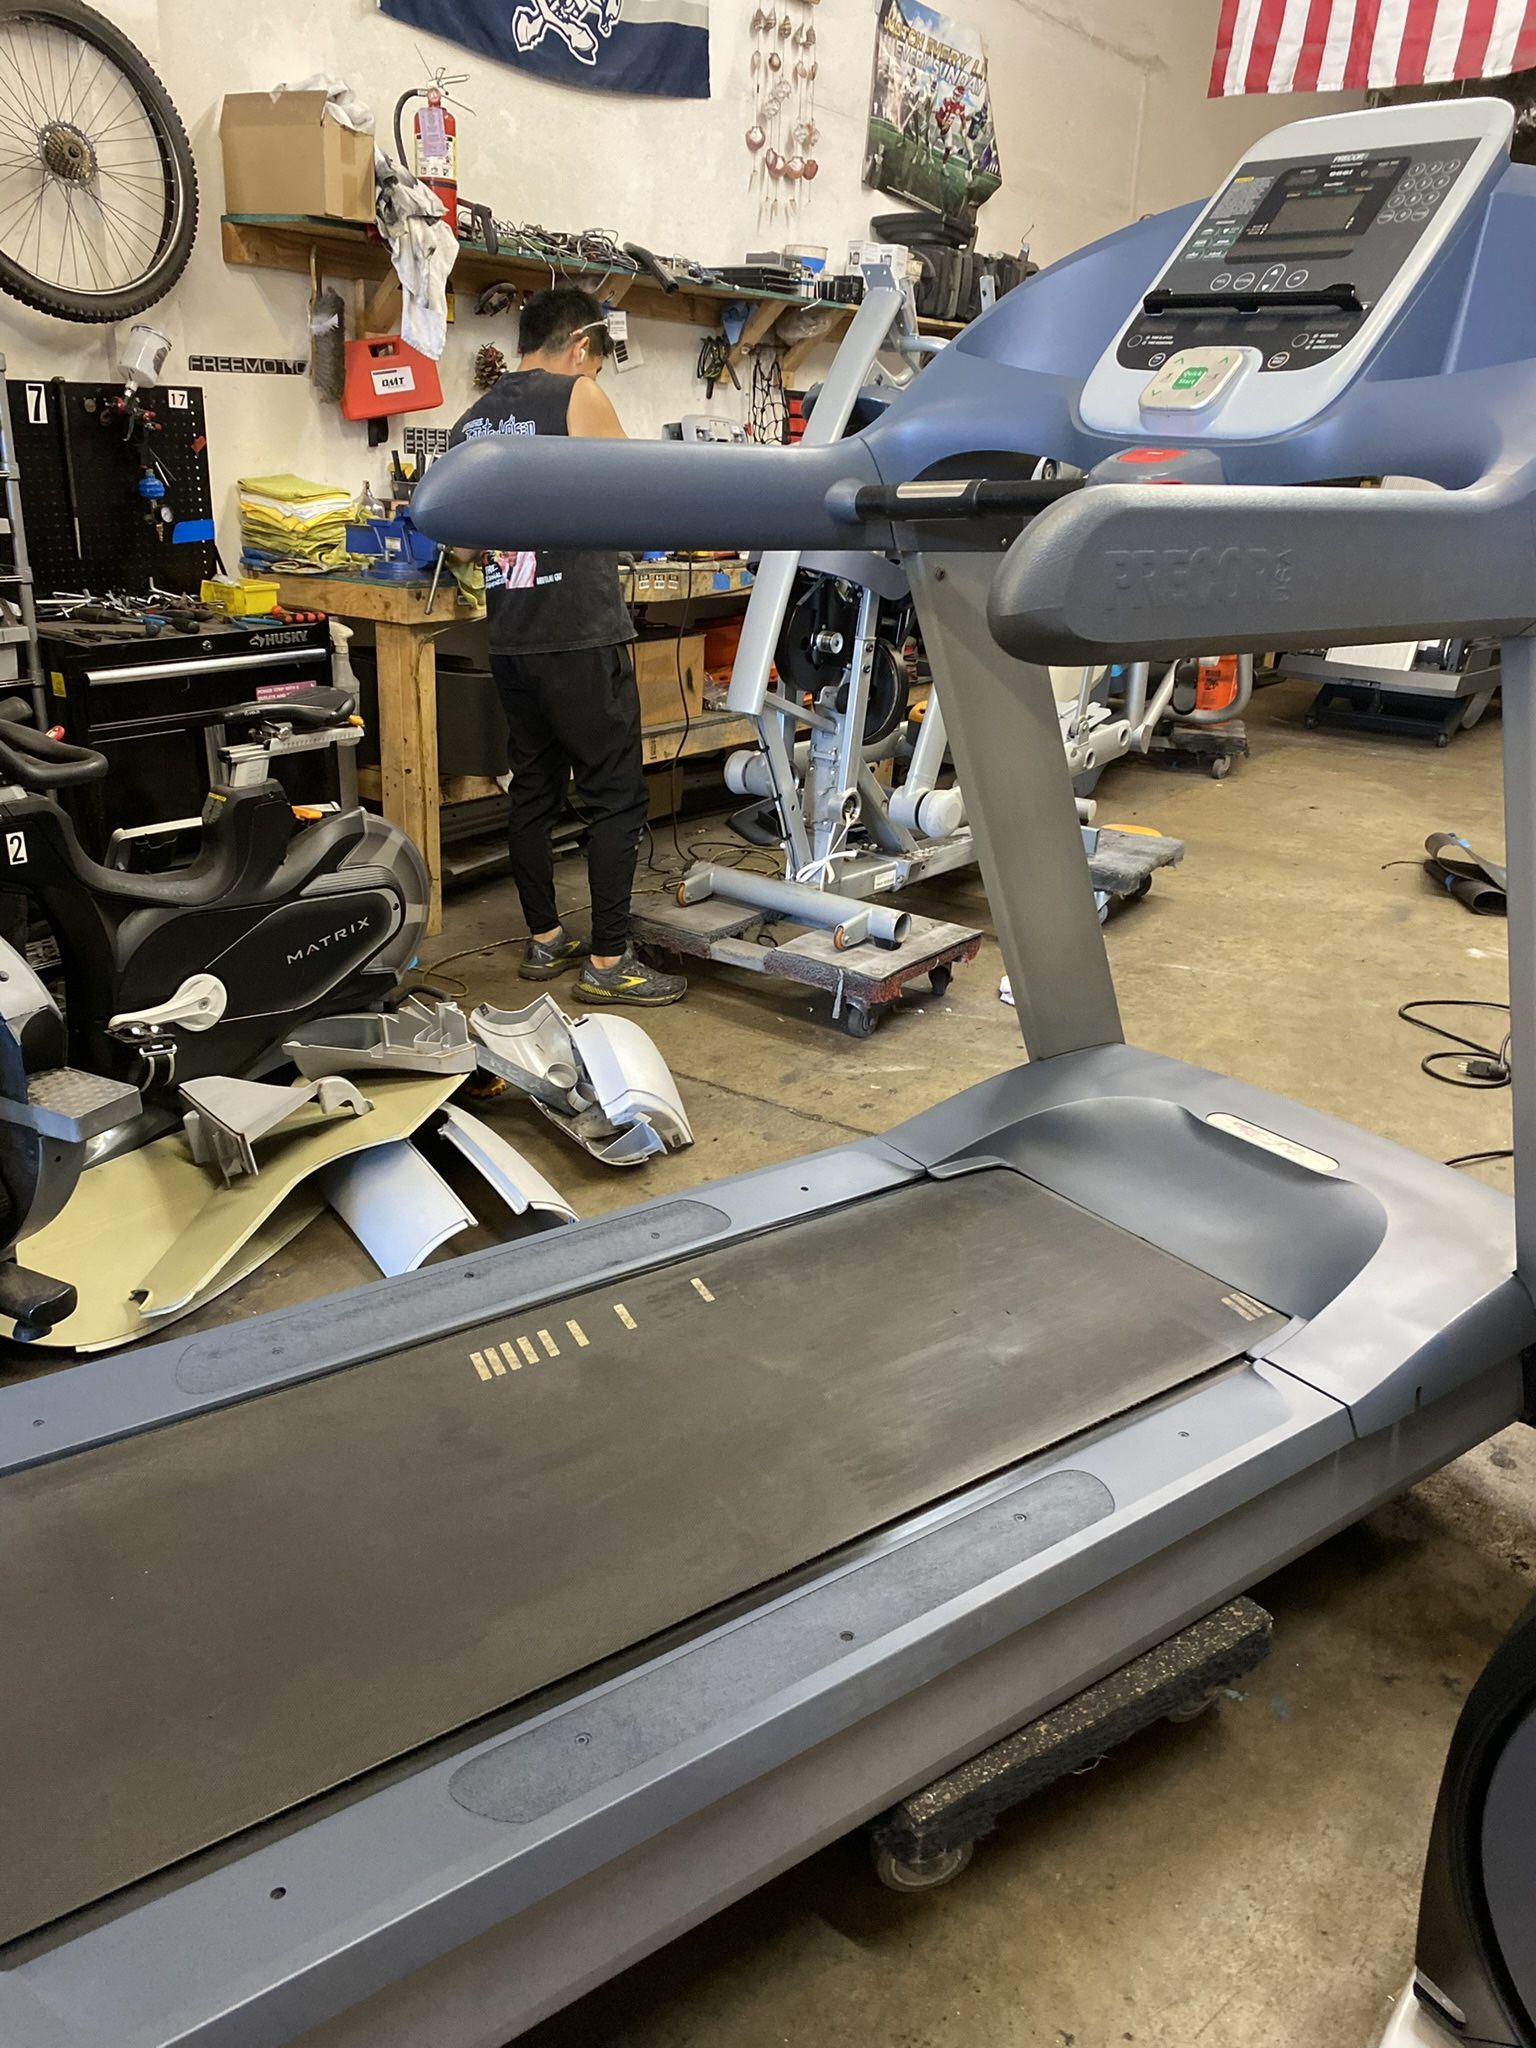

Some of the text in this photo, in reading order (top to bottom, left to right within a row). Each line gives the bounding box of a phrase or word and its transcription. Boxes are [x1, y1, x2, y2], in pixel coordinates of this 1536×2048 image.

[925, 36, 972, 72] EVERY
[932, 59, 986, 96] SUNDAY
[190, 356, 309, 375] FREEMOTIO
[28, 385, 43, 422] 7
[170, 393, 186, 406] 17
[405, 428, 450, 442] FREE
[1103, 546, 1272, 611] PRECOR
[265, 630, 308, 646] HUSKY
[9, 835, 25, 863] 2
[286, 916, 370, 965] MATRIX
